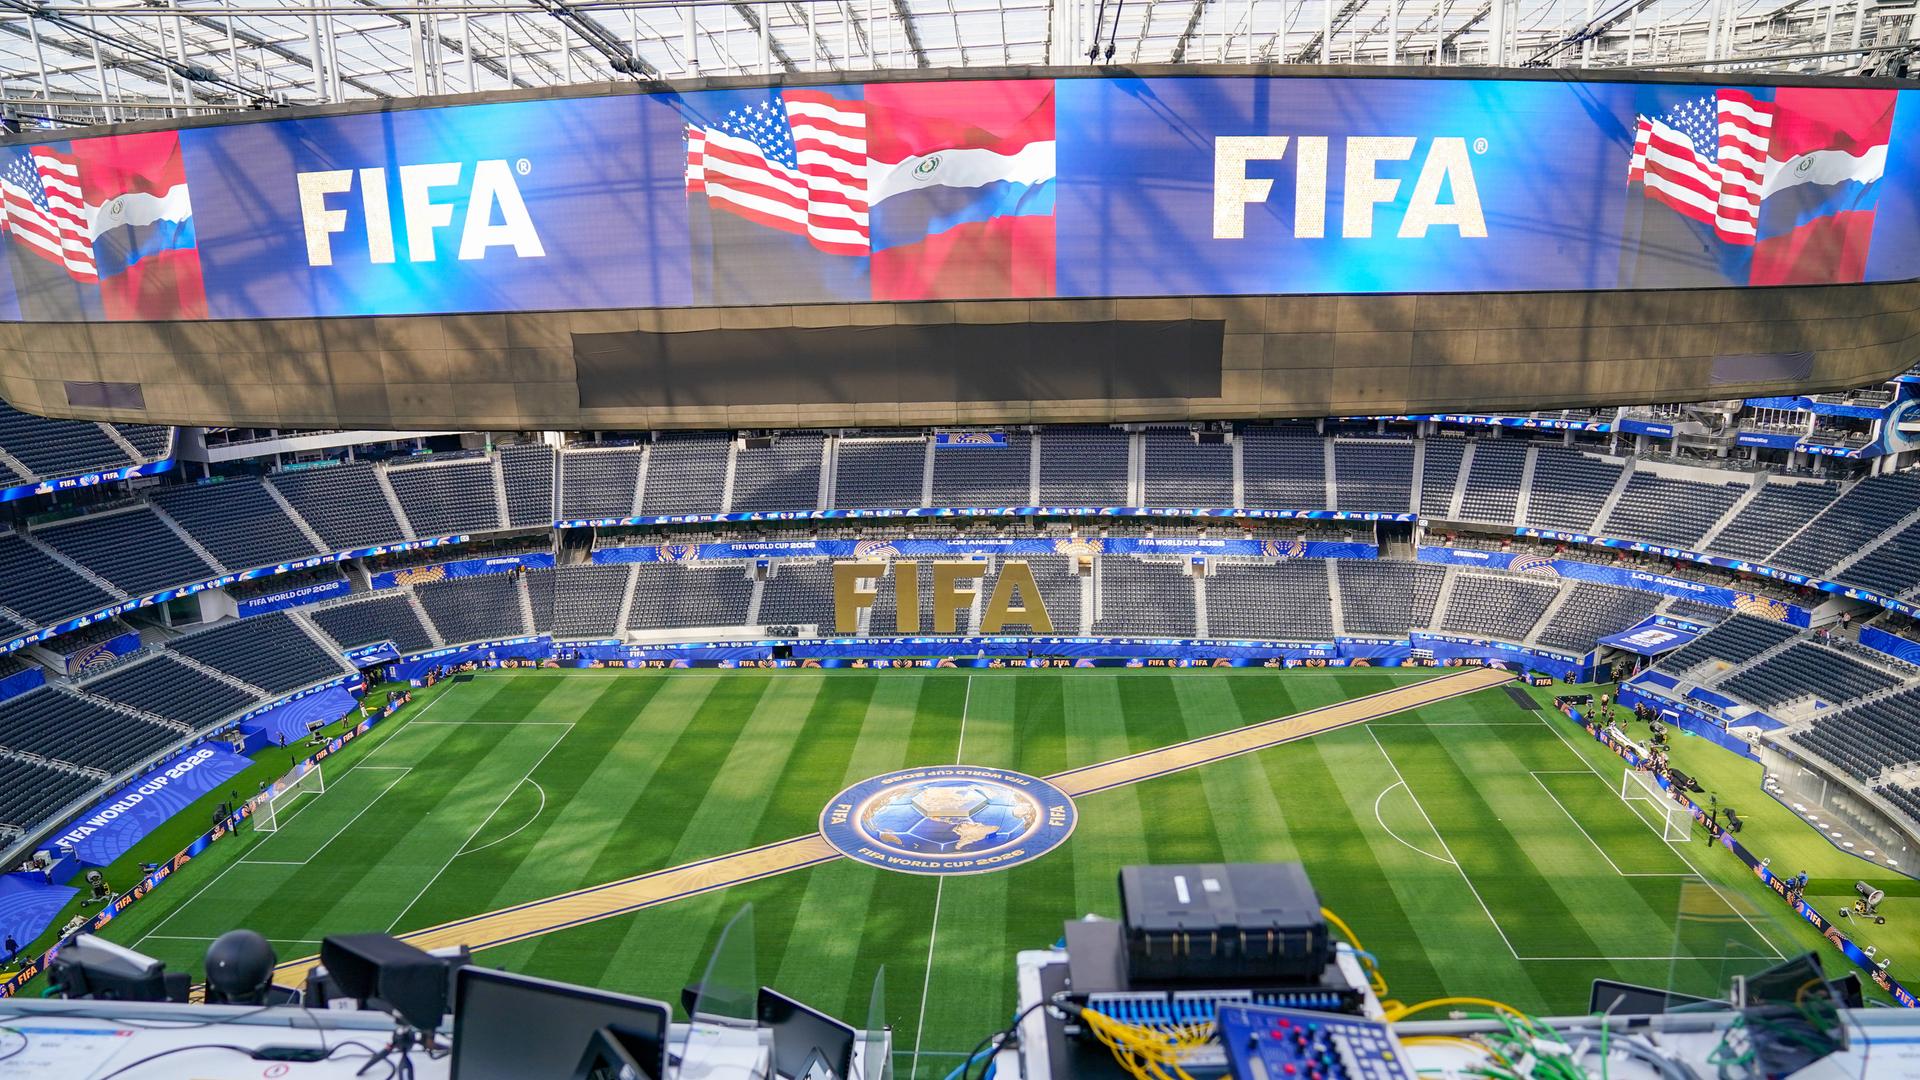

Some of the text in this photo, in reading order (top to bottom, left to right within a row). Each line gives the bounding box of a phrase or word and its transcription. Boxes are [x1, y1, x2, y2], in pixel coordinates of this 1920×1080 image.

[103, 472, 118, 480] FIFA
[1632, 572, 1705, 592] LOS ANGELES
[249, 582, 339, 607] FIFA WORLD CUP 2026
[832, 560, 1054, 633] FIFA
[1789, 574, 1801, 582] FIFA
[1866, 594, 1877, 602] FIFA
[1897, 604, 1909, 613] FIFA
[27, 635, 39, 644] FIFA
[124, 602, 135, 610] FIFA
[1536, 678, 1552, 686] FIFA
[316, 749, 328, 761] FIFA
[343, 731, 354, 743] FIFA
[880, 772, 925, 784] 2026
[956, 770, 1002, 778] WORLD
[1004, 775, 1030, 785] FIFA
[55, 749, 214, 849] FIFA WORLD CUP 2026
[831, 804, 852, 825] FIFA
[1049, 805, 1066, 826] FIFA
[858, 848, 885, 861] FIFA
[888, 857, 940, 868] WORLD
[976, 849, 1025, 865] 2026
[1706, 816, 1718, 834] FIA
[1770, 877, 1784, 895] FIFA
[1806, 909, 1821, 928] FIFA
[1895, 989, 1915, 1008] FIFA
[18, 866, 170, 985] FIFA FIFA FIFA
